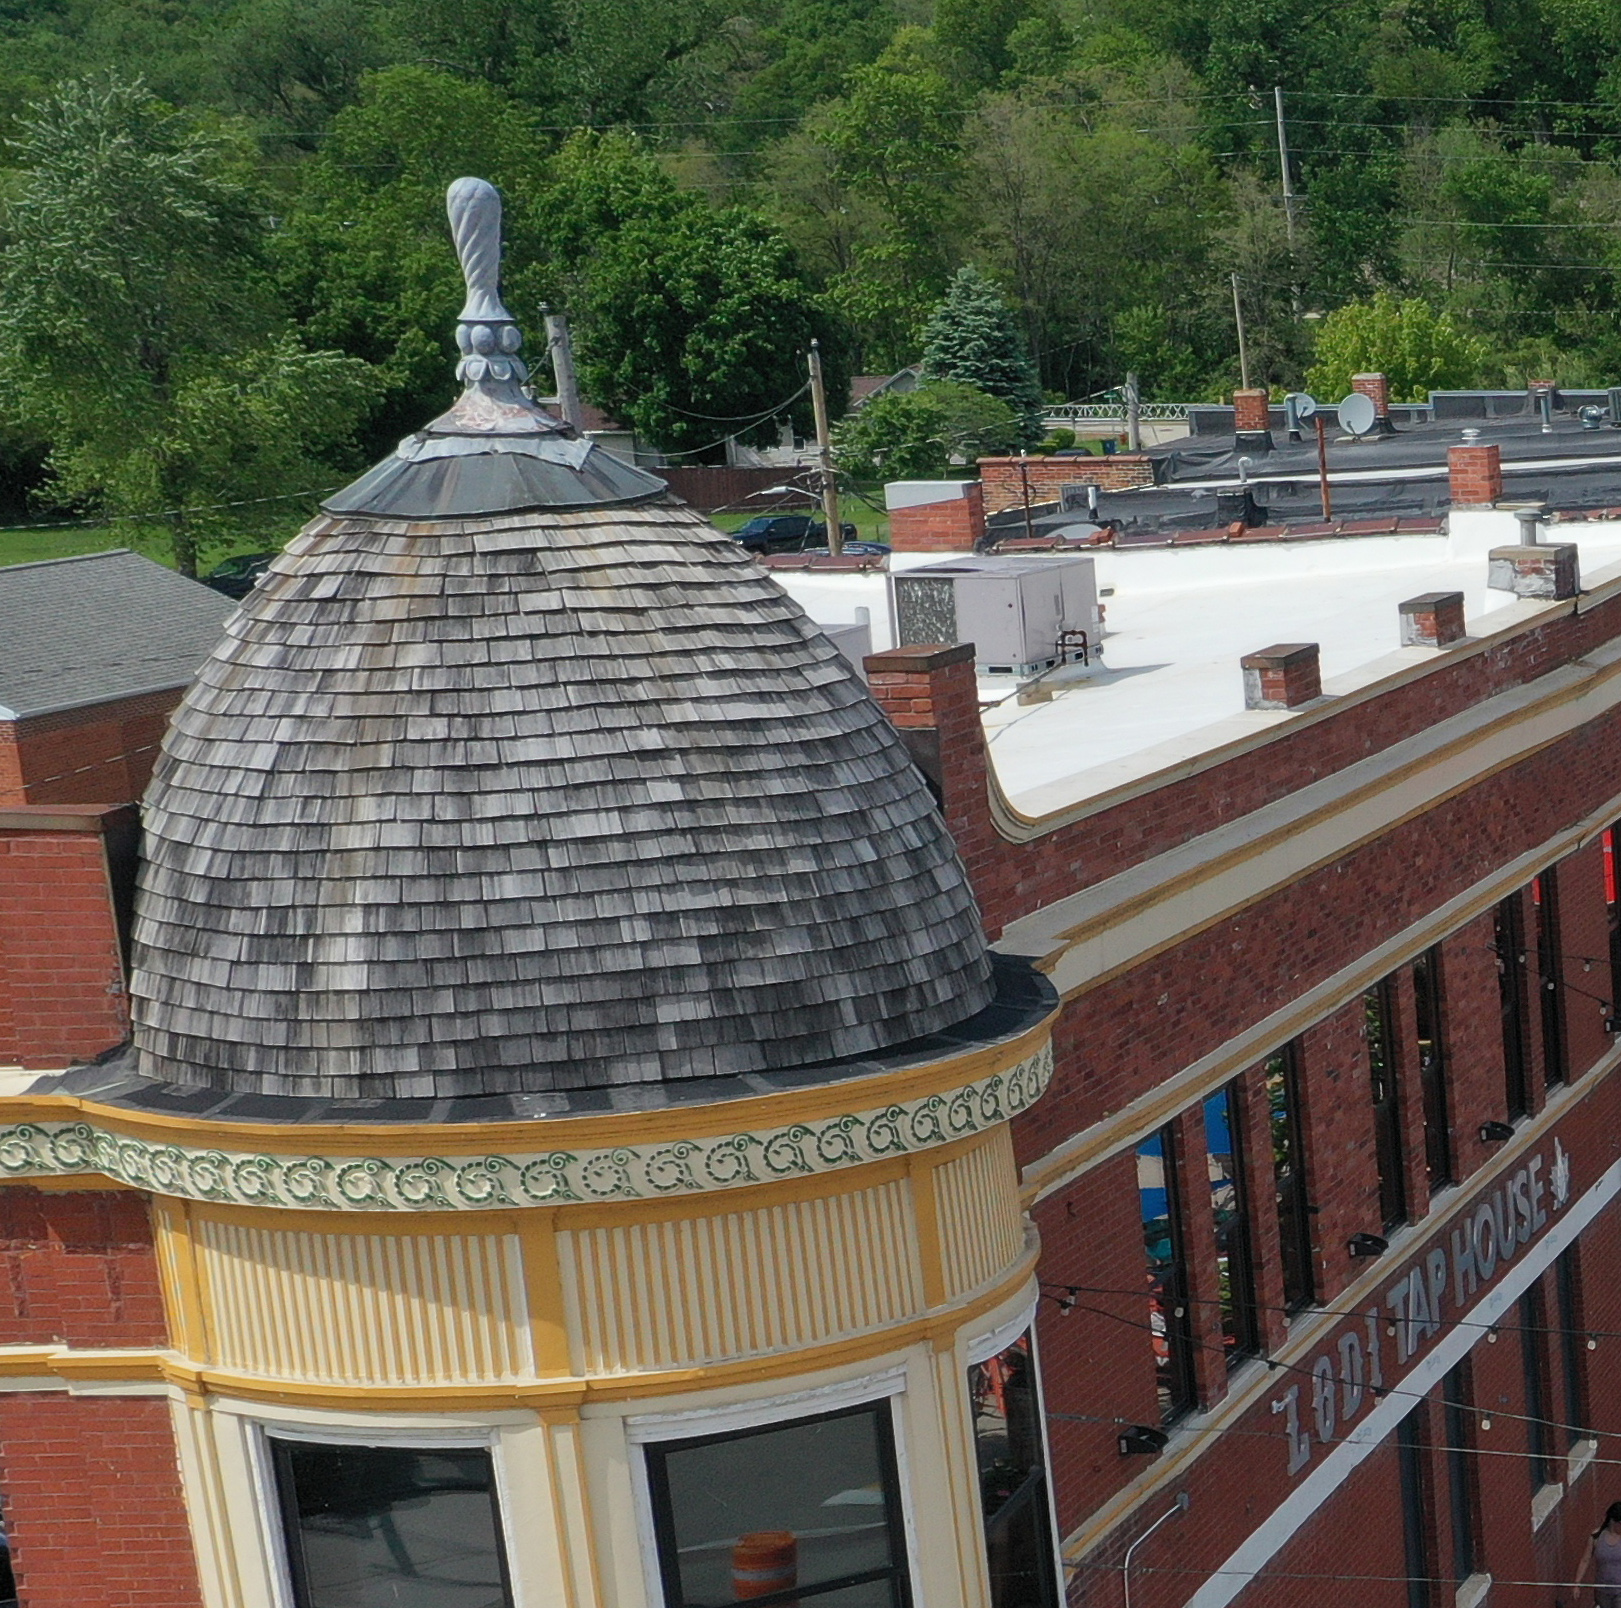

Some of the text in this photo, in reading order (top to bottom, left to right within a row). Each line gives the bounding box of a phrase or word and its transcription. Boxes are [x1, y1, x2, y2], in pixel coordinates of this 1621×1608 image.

[1284, 1153, 1547, 1477] LODI TAP HOUSE
